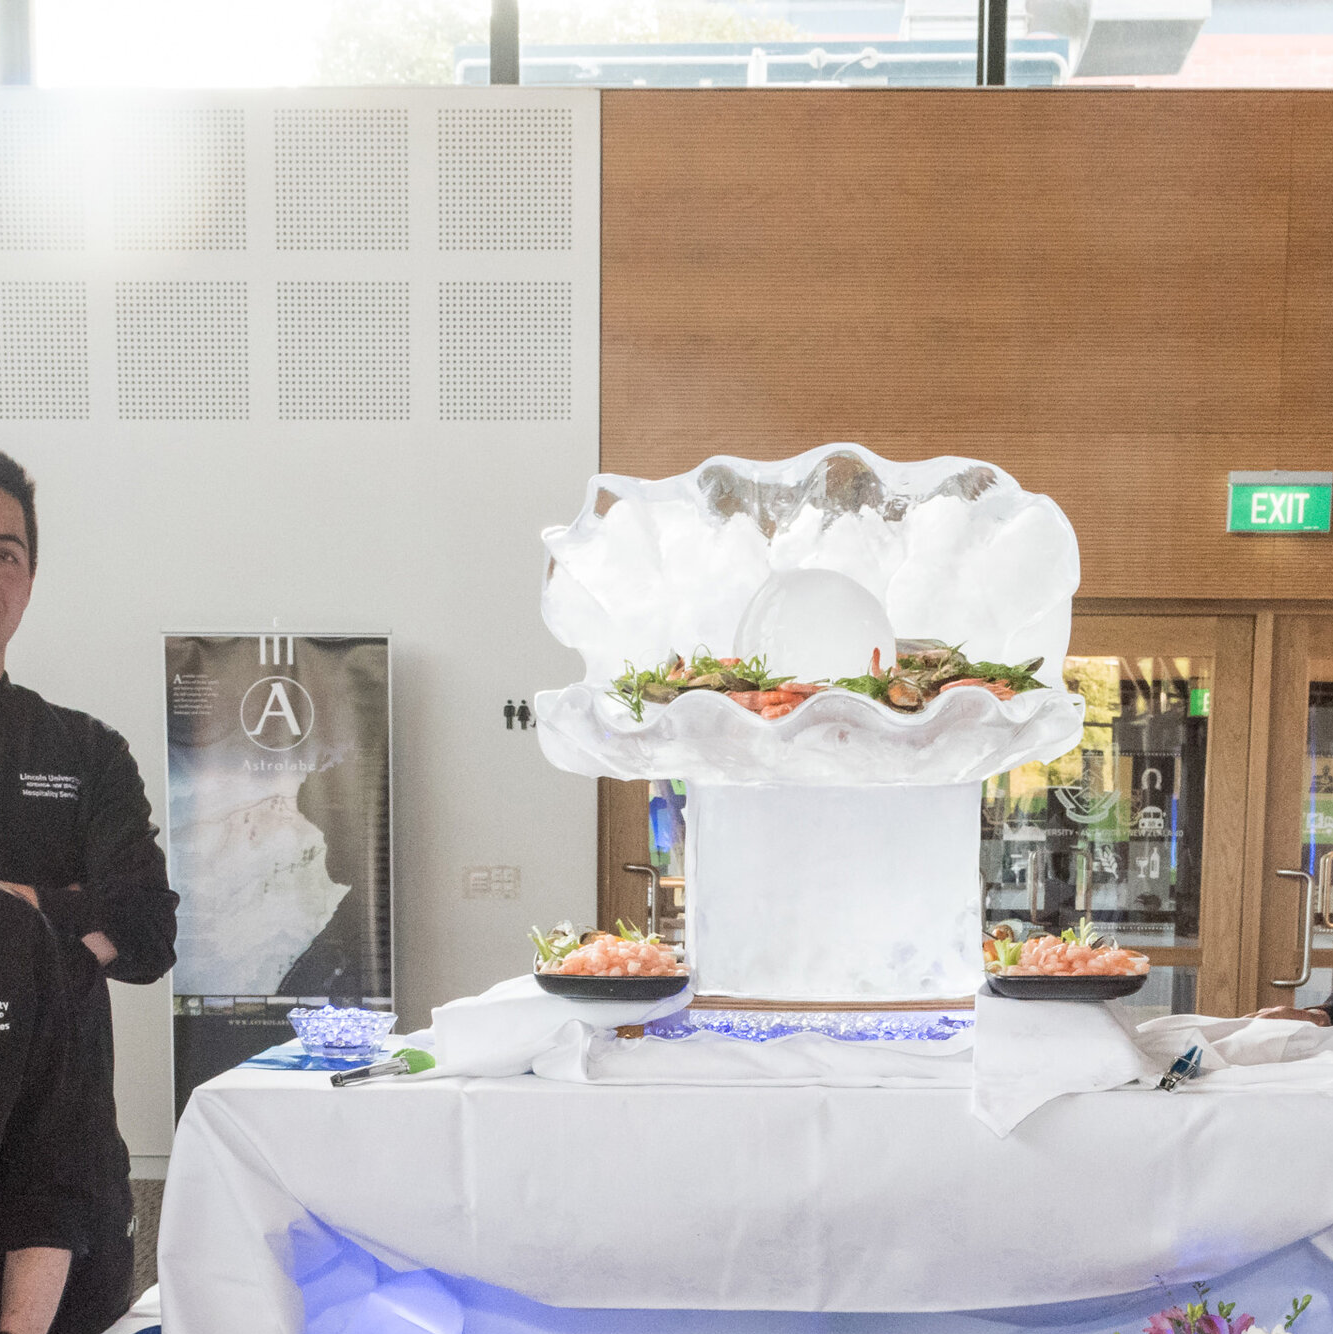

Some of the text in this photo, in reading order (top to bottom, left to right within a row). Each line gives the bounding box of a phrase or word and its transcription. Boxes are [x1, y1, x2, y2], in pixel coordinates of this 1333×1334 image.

[1251, 492, 1310, 524] EXIT
[248, 682, 302, 736] A
[243, 759, 316, 771] Astrolabe
[20, 773, 47, 781] Lincoln
